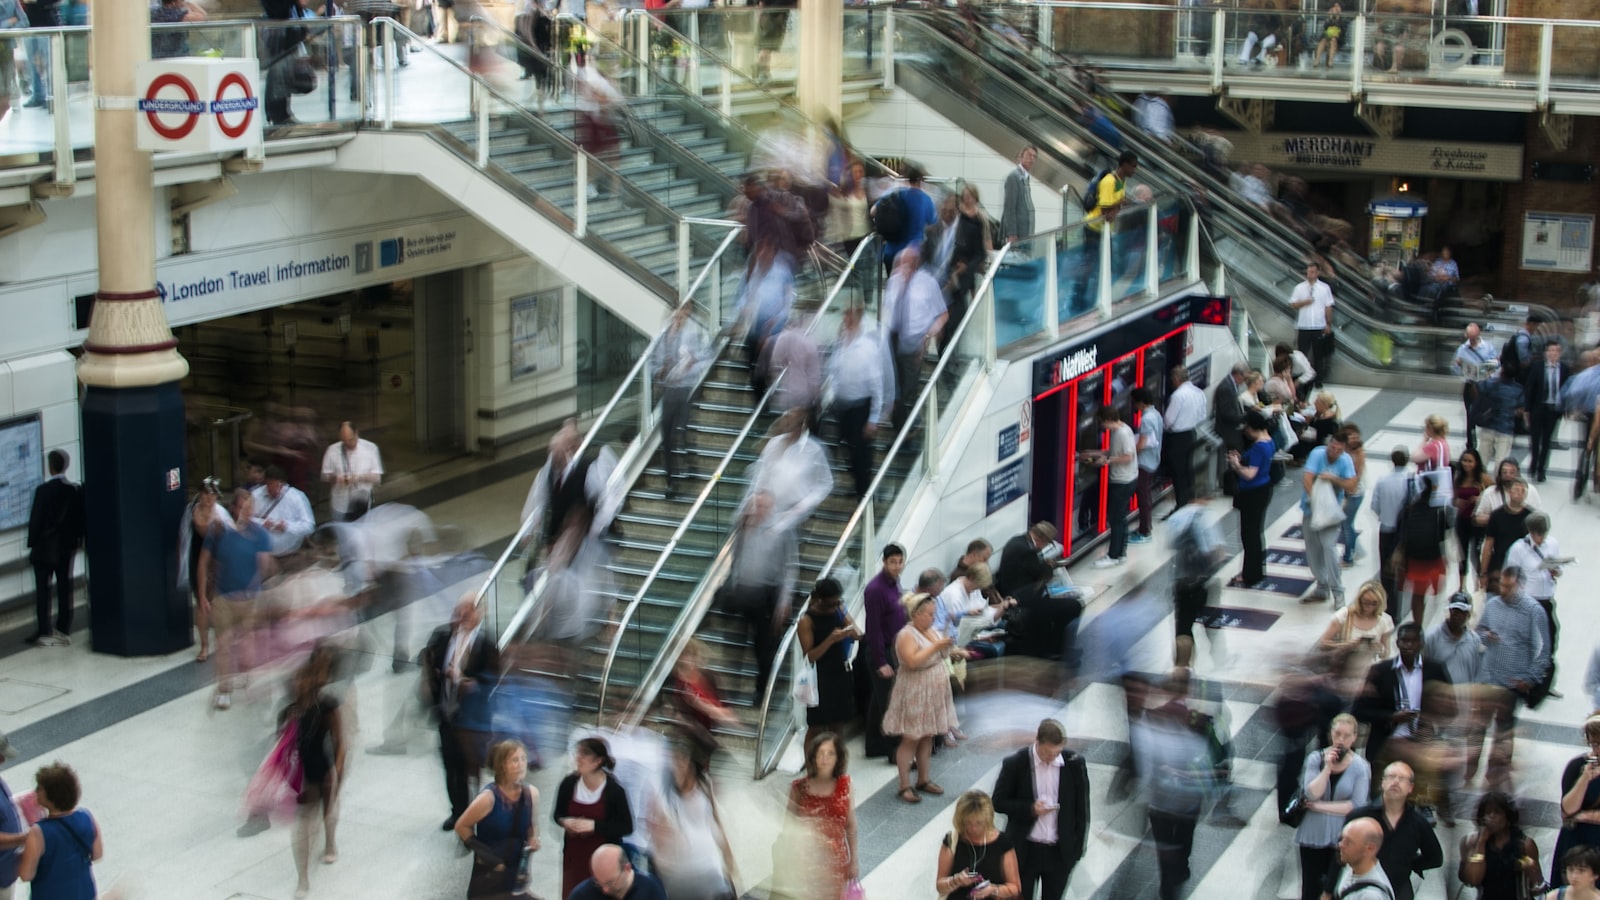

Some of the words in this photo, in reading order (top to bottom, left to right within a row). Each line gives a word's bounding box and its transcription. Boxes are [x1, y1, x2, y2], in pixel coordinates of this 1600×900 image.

[142, 100, 203, 110] UNDERGROUND
[213, 99, 257, 111] UNDERGROUND
[1284, 136, 1376, 156] MERCHANT
[1432, 146, 1488, 159] Freehouse
[1447, 158, 1486, 170] Kitchen
[172, 277, 224, 301] London
[229, 266, 271, 289] Travel
[276, 253, 350, 281] Information
[1062, 344, 1098, 382] NatWest
